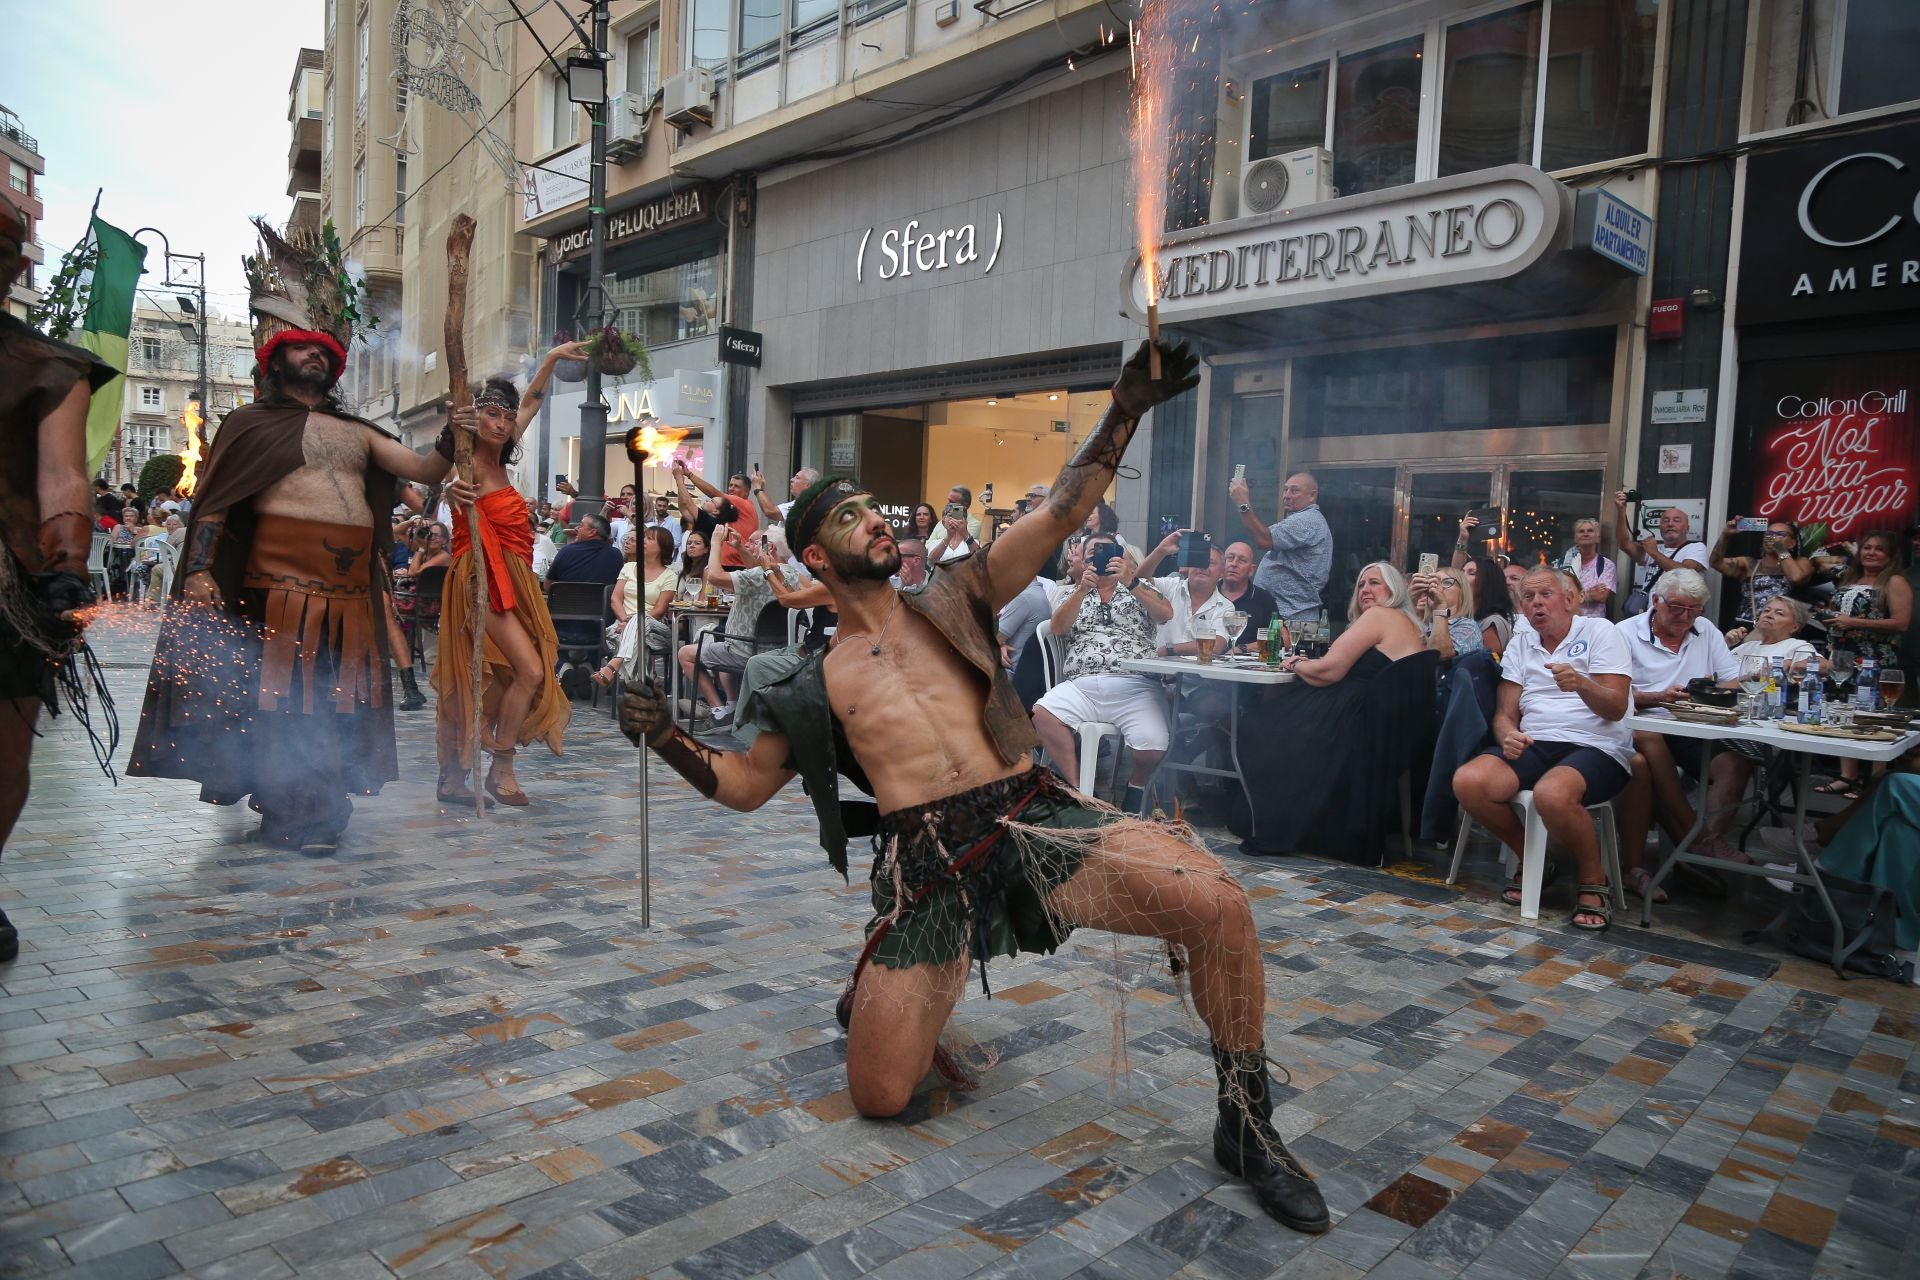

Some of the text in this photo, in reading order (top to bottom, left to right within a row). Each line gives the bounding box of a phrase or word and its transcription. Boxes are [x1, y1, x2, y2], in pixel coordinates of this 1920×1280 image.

[1605, 202, 1642, 241] ALQUILER
[1798, 152, 1920, 247] C
[555, 228, 606, 260] yolan
[1155, 198, 1524, 299] MEDITERRANEO
[1594, 224, 1647, 268] APARTAMENTOS
[1653, 304, 1679, 313] FUEGO
[600, 389, 656, 423] UNA
[1771, 414, 1880, 471] Nos
[1760, 457, 1905, 515] gusta
[1798, 479, 1908, 533] viajar
[879, 504, 910, 517] NLINE
